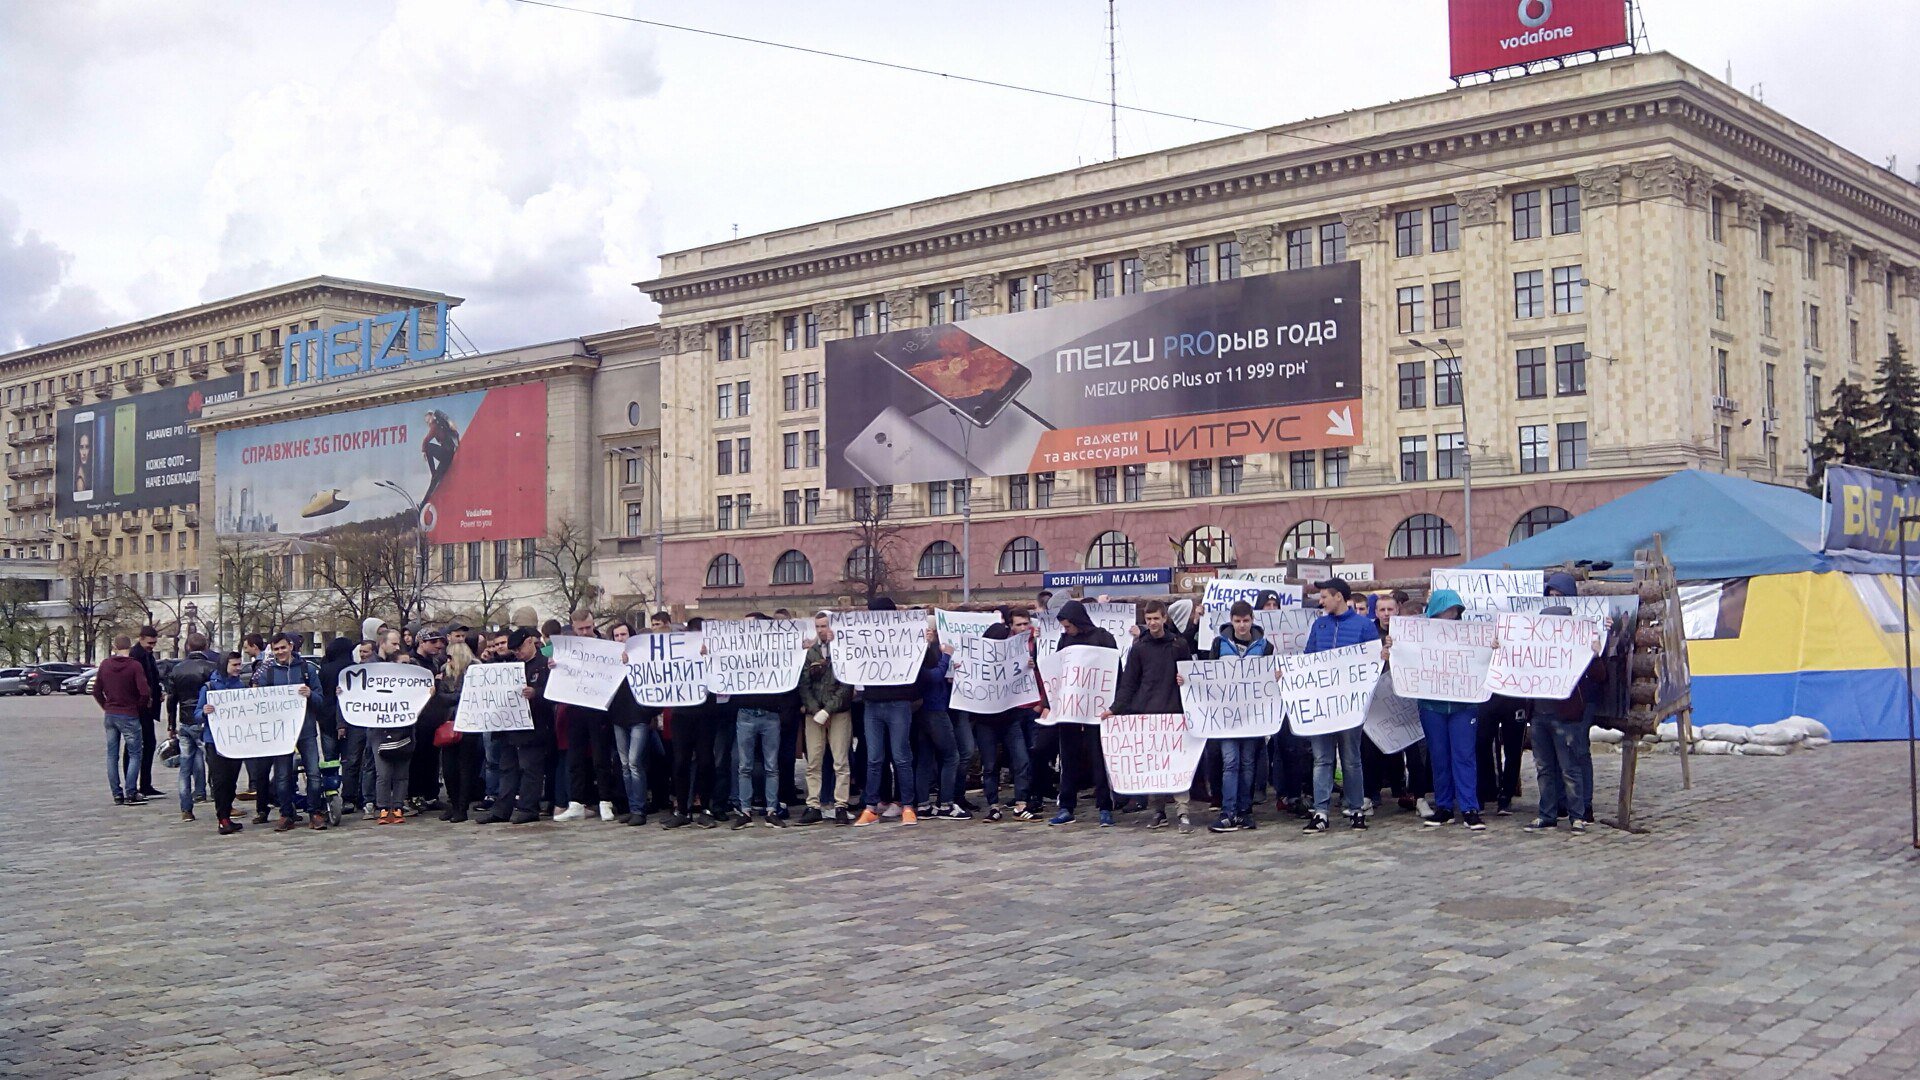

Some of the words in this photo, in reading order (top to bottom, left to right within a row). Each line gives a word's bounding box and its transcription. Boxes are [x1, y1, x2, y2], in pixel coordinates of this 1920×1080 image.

[1499, 25, 1573, 50] vodafone
[284, 301, 447, 386] MEIZU
[1056, 338, 1155, 373] MEIZU
[1276, 319, 1337, 348] года
[1084, 381, 1127, 399] MEIZU
[1131, 375, 1169, 394] PRO6
[1172, 371, 1202, 388] Plus
[1205, 372, 1222, 384] от
[1226, 367, 1242, 382] 11
[1247, 362, 1275, 380] 999
[205, 391, 238, 405] HUAWEI
[146, 428, 173, 440] HUAWEI
[1076, 430, 1138, 447] гаджети
[1146, 416, 1301, 455] ЦИТРУС
[242, 440, 311, 465] СПРАВЖНЄ
[313, 435, 329, 456] 3G
[333, 424, 408, 453] ПОКРИТТЯ
[1044, 452, 1059, 464] та
[1063, 444, 1138, 463] аксесуари
[146, 457, 167, 471] КОЖНЕ
[167, 455, 185, 467] ФОТО
[146, 476, 161, 488] НАЧЕ
[1052, 573, 1103, 586] ЮВЕЛІРНИЙ
[1112, 573, 1158, 583] МАГАЗИН
[703, 620, 745, 636] ТАРИФЫ
[749, 620, 763, 633] НА
[766, 619, 799, 632] ЖКХ
[830, 611, 927, 627] МЕДИЦИНСКАЯ
[1496, 613, 1518, 642] НЕ
[650, 634, 685, 661] НЕ
[837, 628, 926, 647] РЕФОРМА
[846, 645, 926, 662] БОЛЬНИЦУ
[960, 636, 979, 661] НЕ
[1492, 645, 1509, 668] НА
[1512, 645, 1572, 670] НАШЕМ
[704, 657, 713, 674] И
[720, 651, 793, 672] БОЛЬНИЦЫ
[857, 661, 892, 681] 100
[1188, 655, 1276, 681] ДЕПУТАТИ
[1279, 654, 1294, 673] НЕ
[1280, 667, 1340, 692] ЛЮДЕЙ
[1349, 661, 1380, 684] БЕЗ
[1161, 714, 1175, 732] НА
[1186, 711, 1194, 729] В
[1102, 734, 1186, 755] ПОДНЯЛИ,
